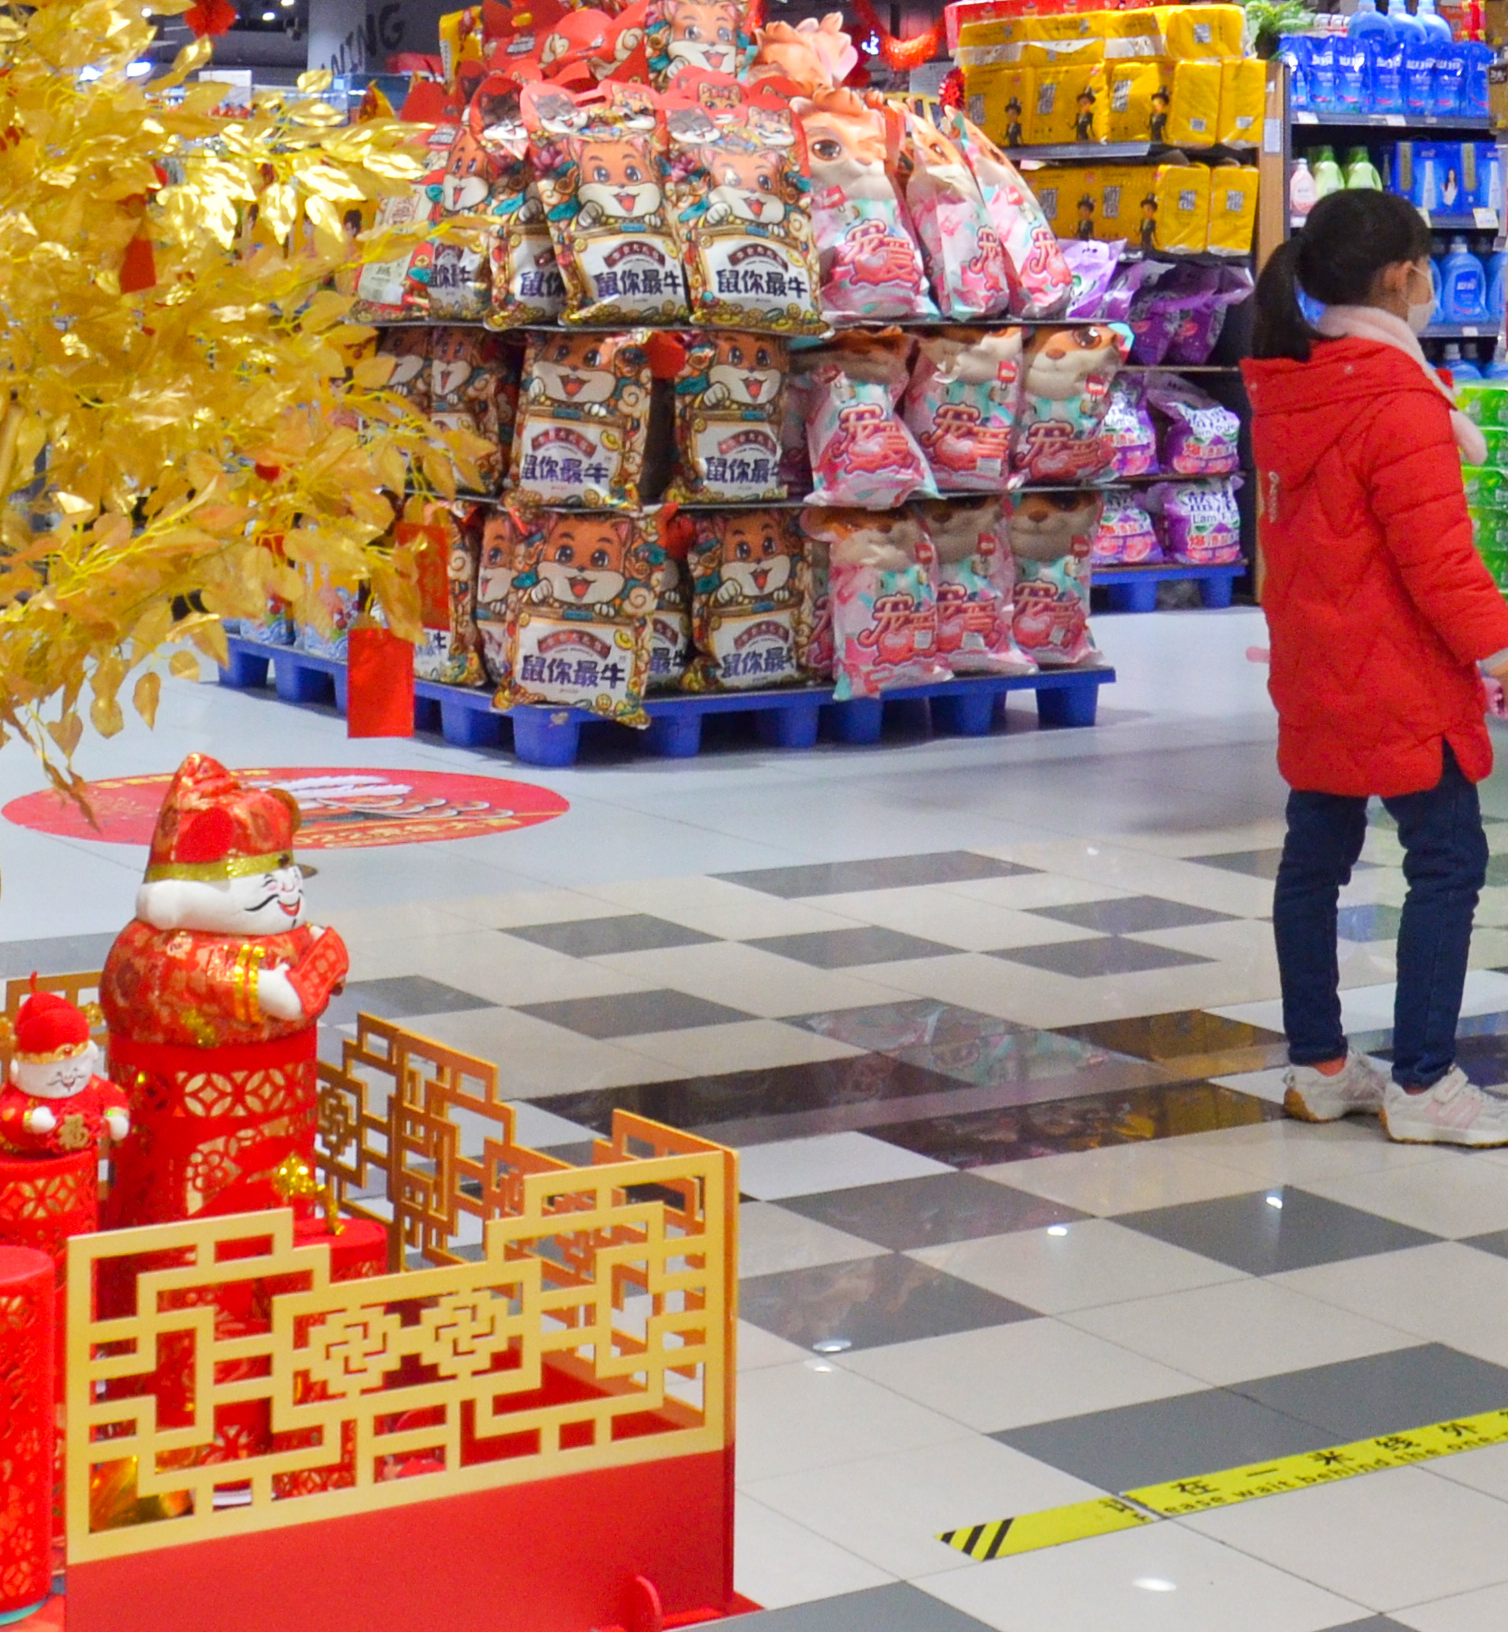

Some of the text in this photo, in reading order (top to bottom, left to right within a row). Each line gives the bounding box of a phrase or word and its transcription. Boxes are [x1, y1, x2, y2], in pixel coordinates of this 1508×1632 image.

[593, 269, 682, 300] 鼠你最牛
[715, 268, 808, 299] 鼠你最牛
[520, 453, 610, 485] 鼠你最牛
[520, 655, 626, 690] 鼠你最牛
[1233, 1477, 1291, 1499] wait
